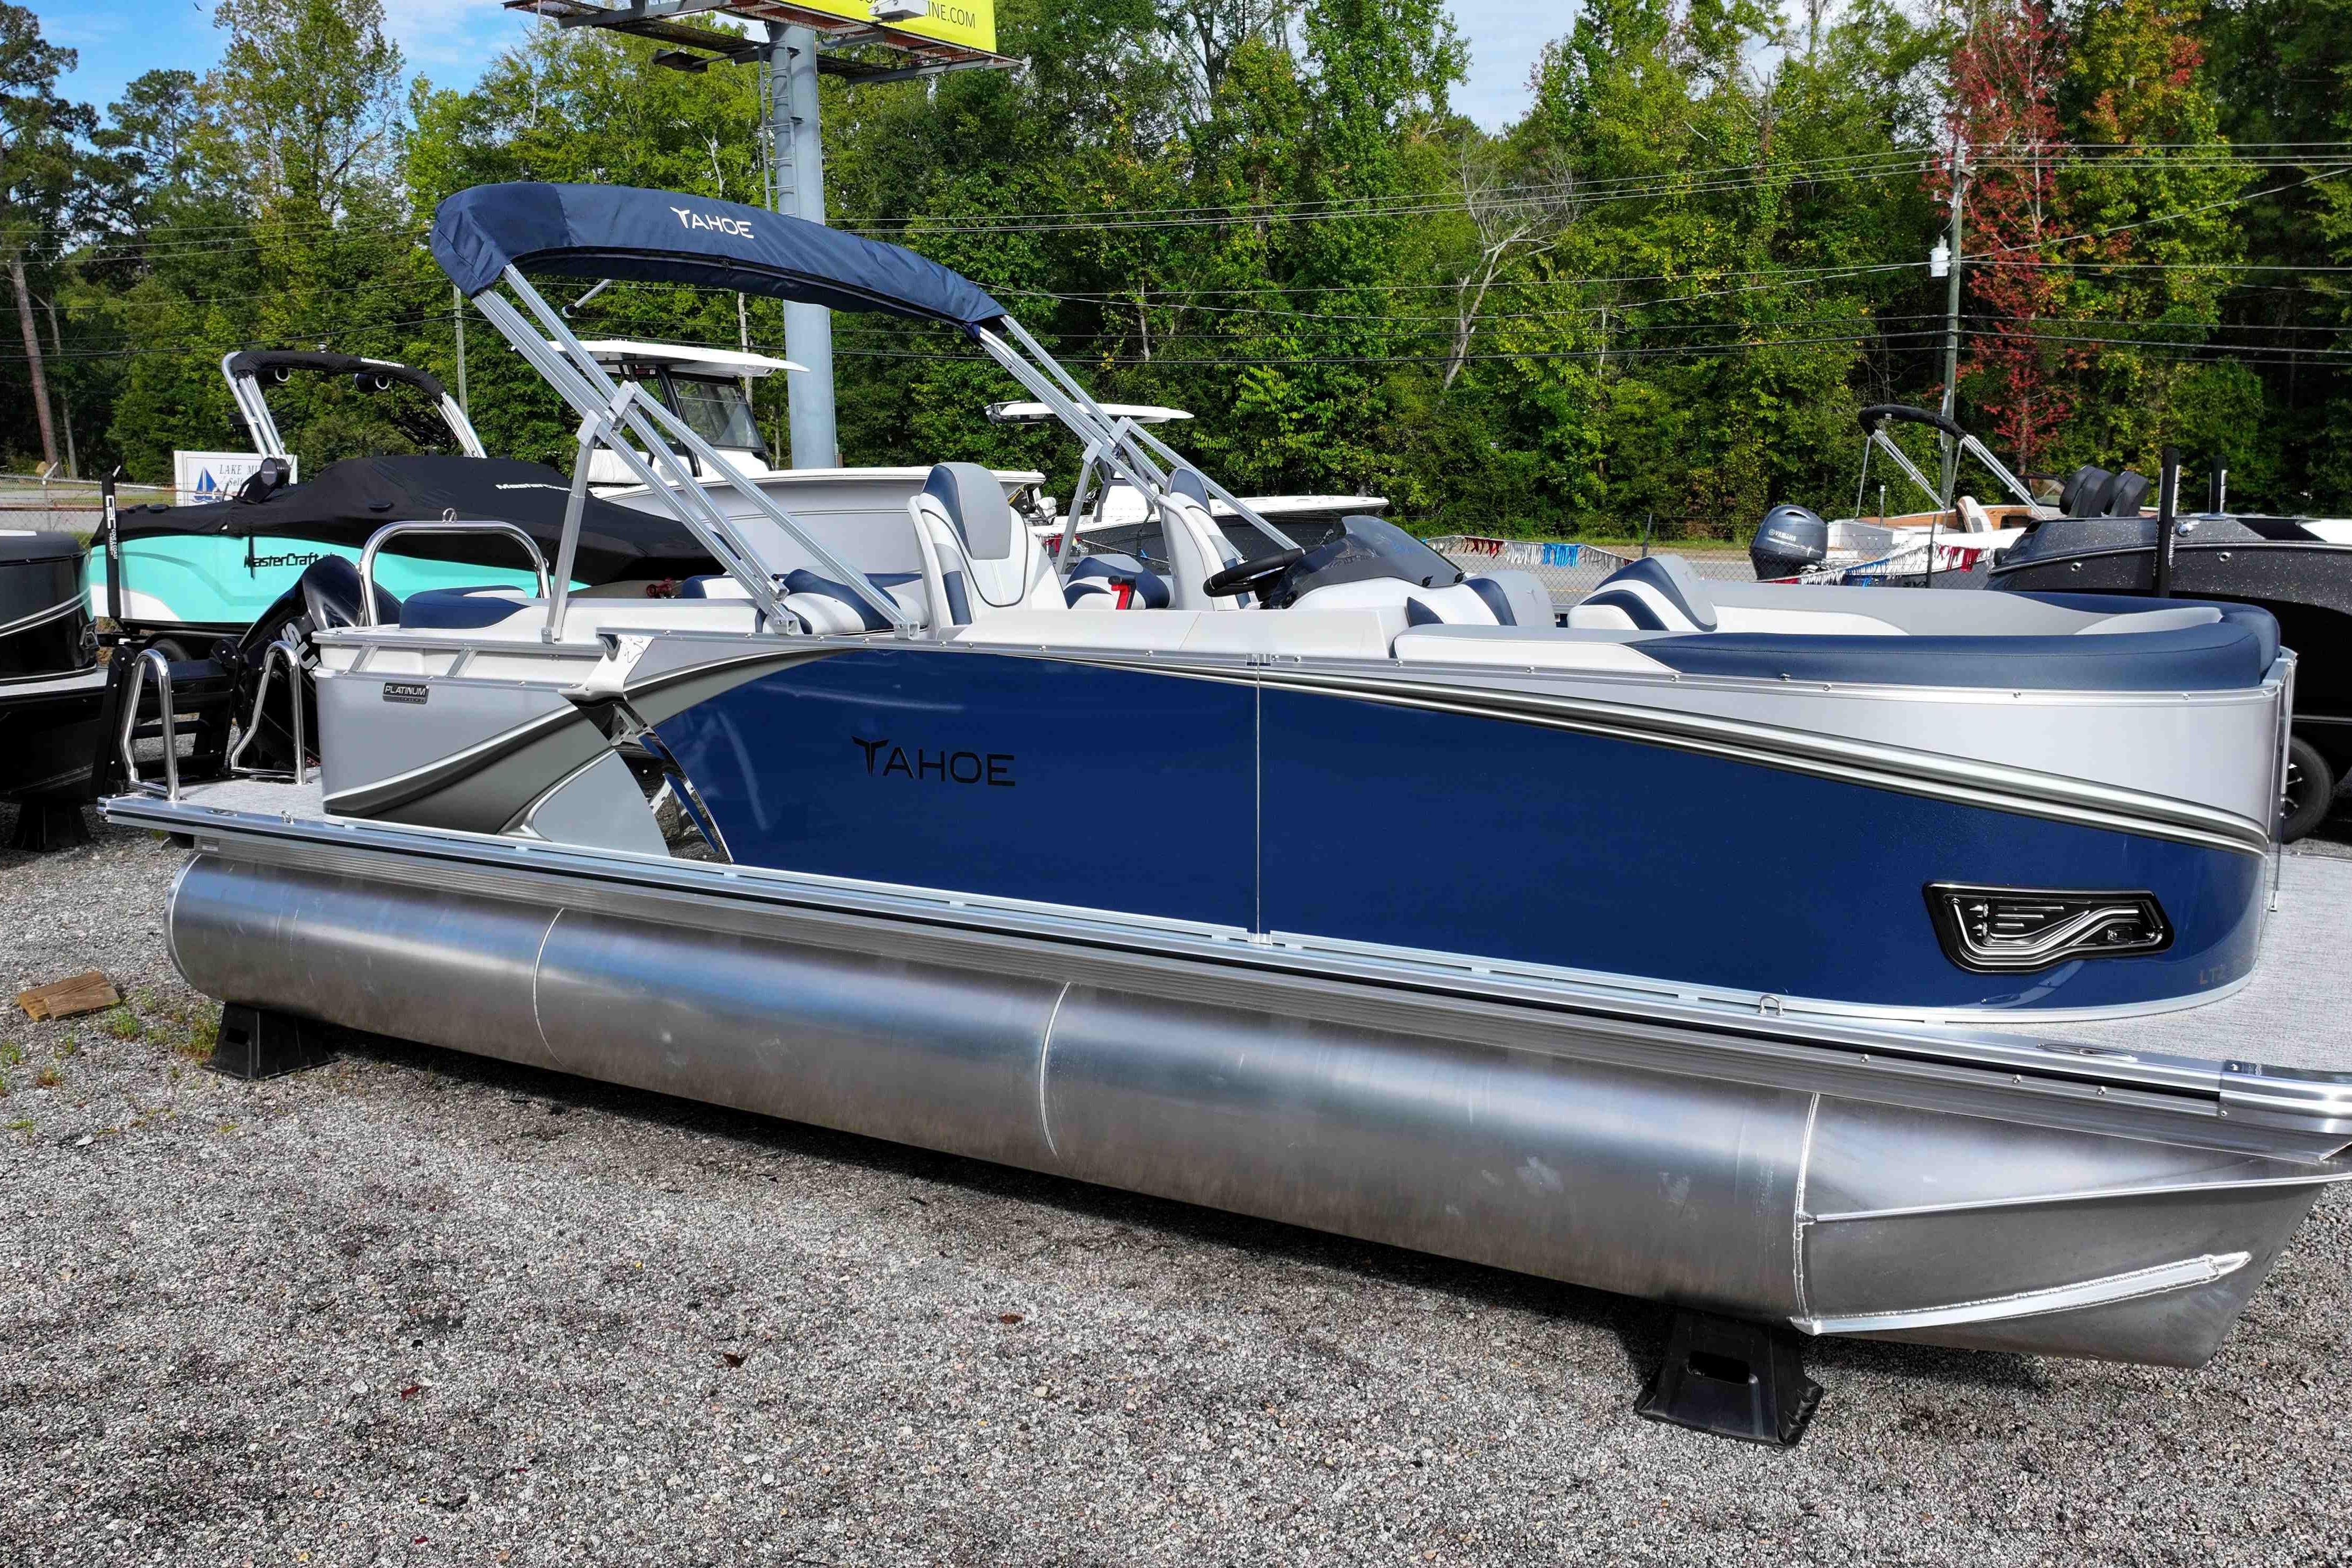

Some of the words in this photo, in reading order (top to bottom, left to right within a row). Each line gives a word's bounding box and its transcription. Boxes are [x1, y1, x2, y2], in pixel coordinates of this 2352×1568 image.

[925, 1, 976, 29] INE.COM
[669, 206, 754, 239] TAHOE
[219, 464, 242, 475] LAKE
[1774, 530, 1797, 542] YAMAHA
[385, 685, 426, 696] PLATINUM
[851, 735, 1016, 787] TAHOE
